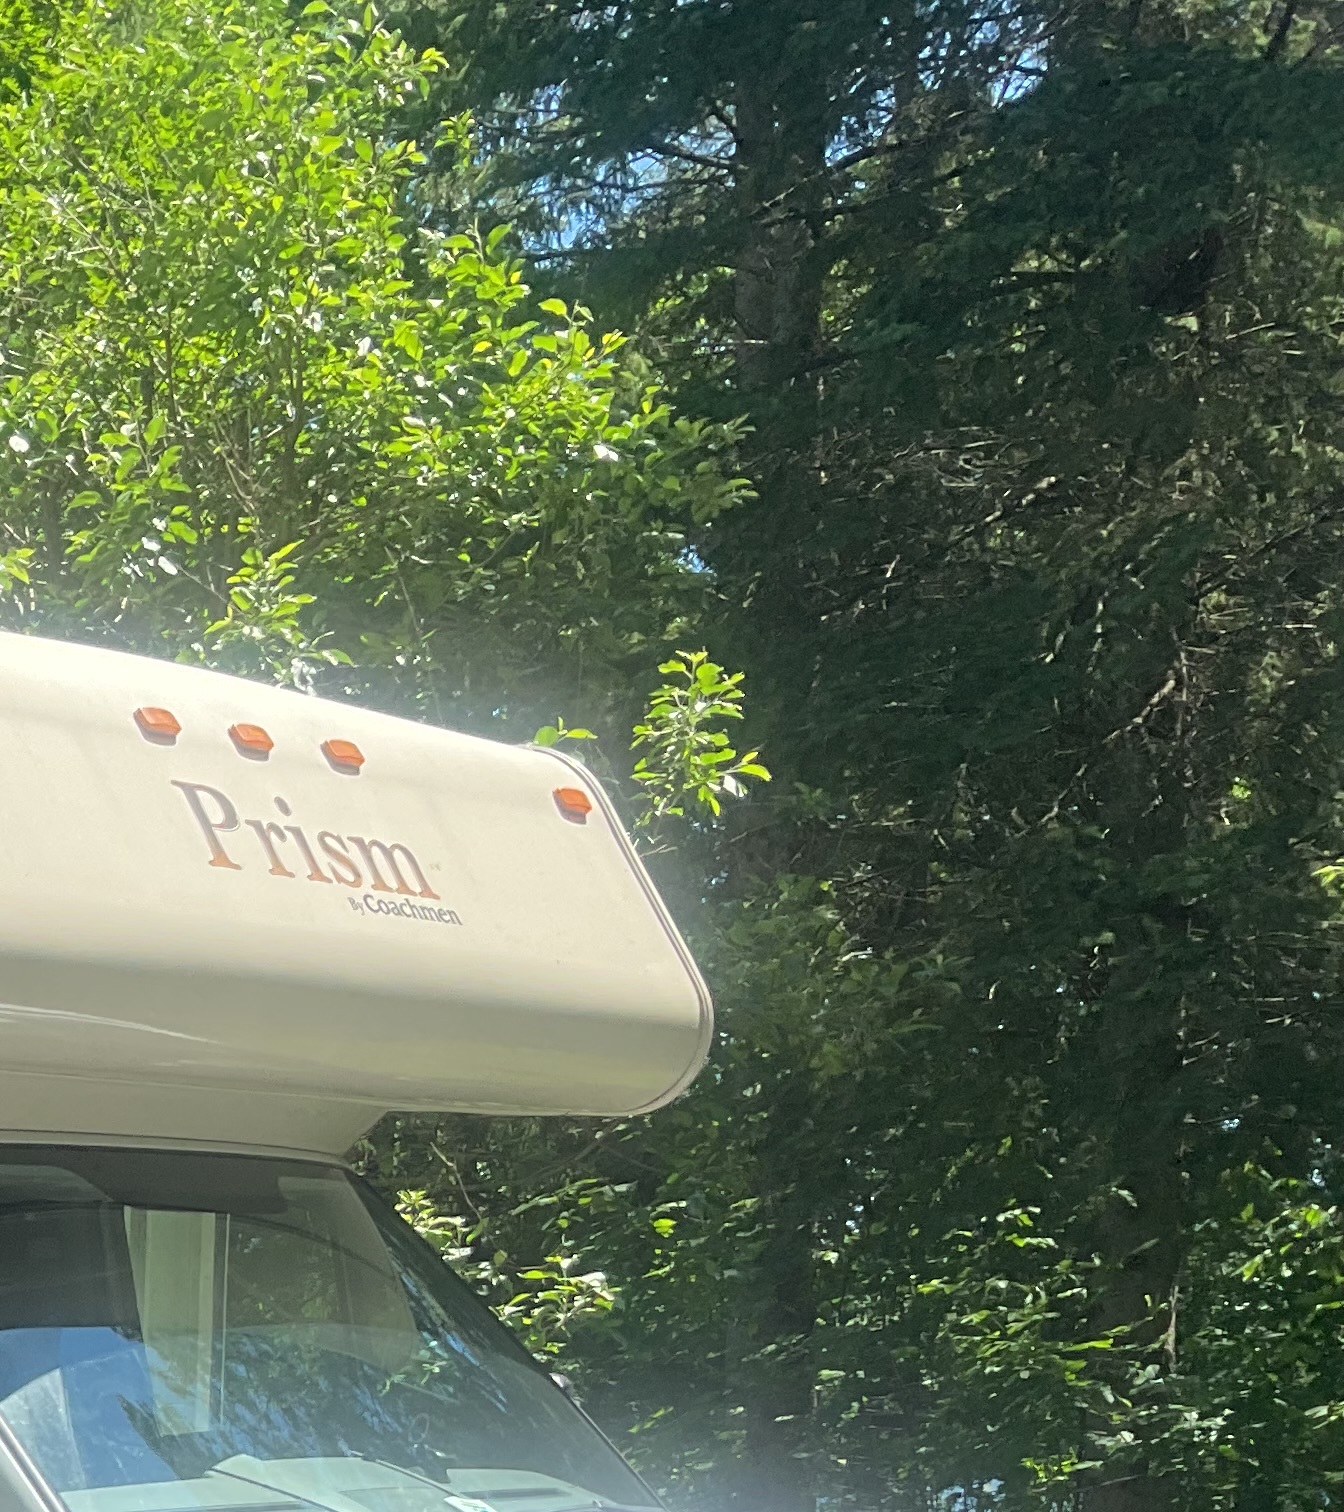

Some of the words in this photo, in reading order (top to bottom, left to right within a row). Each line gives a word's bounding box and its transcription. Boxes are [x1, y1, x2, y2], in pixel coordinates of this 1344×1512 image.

[170, 779, 440, 900] Prism
[347, 896, 365, 916] By
[362, 894, 463, 926] Coachmen
